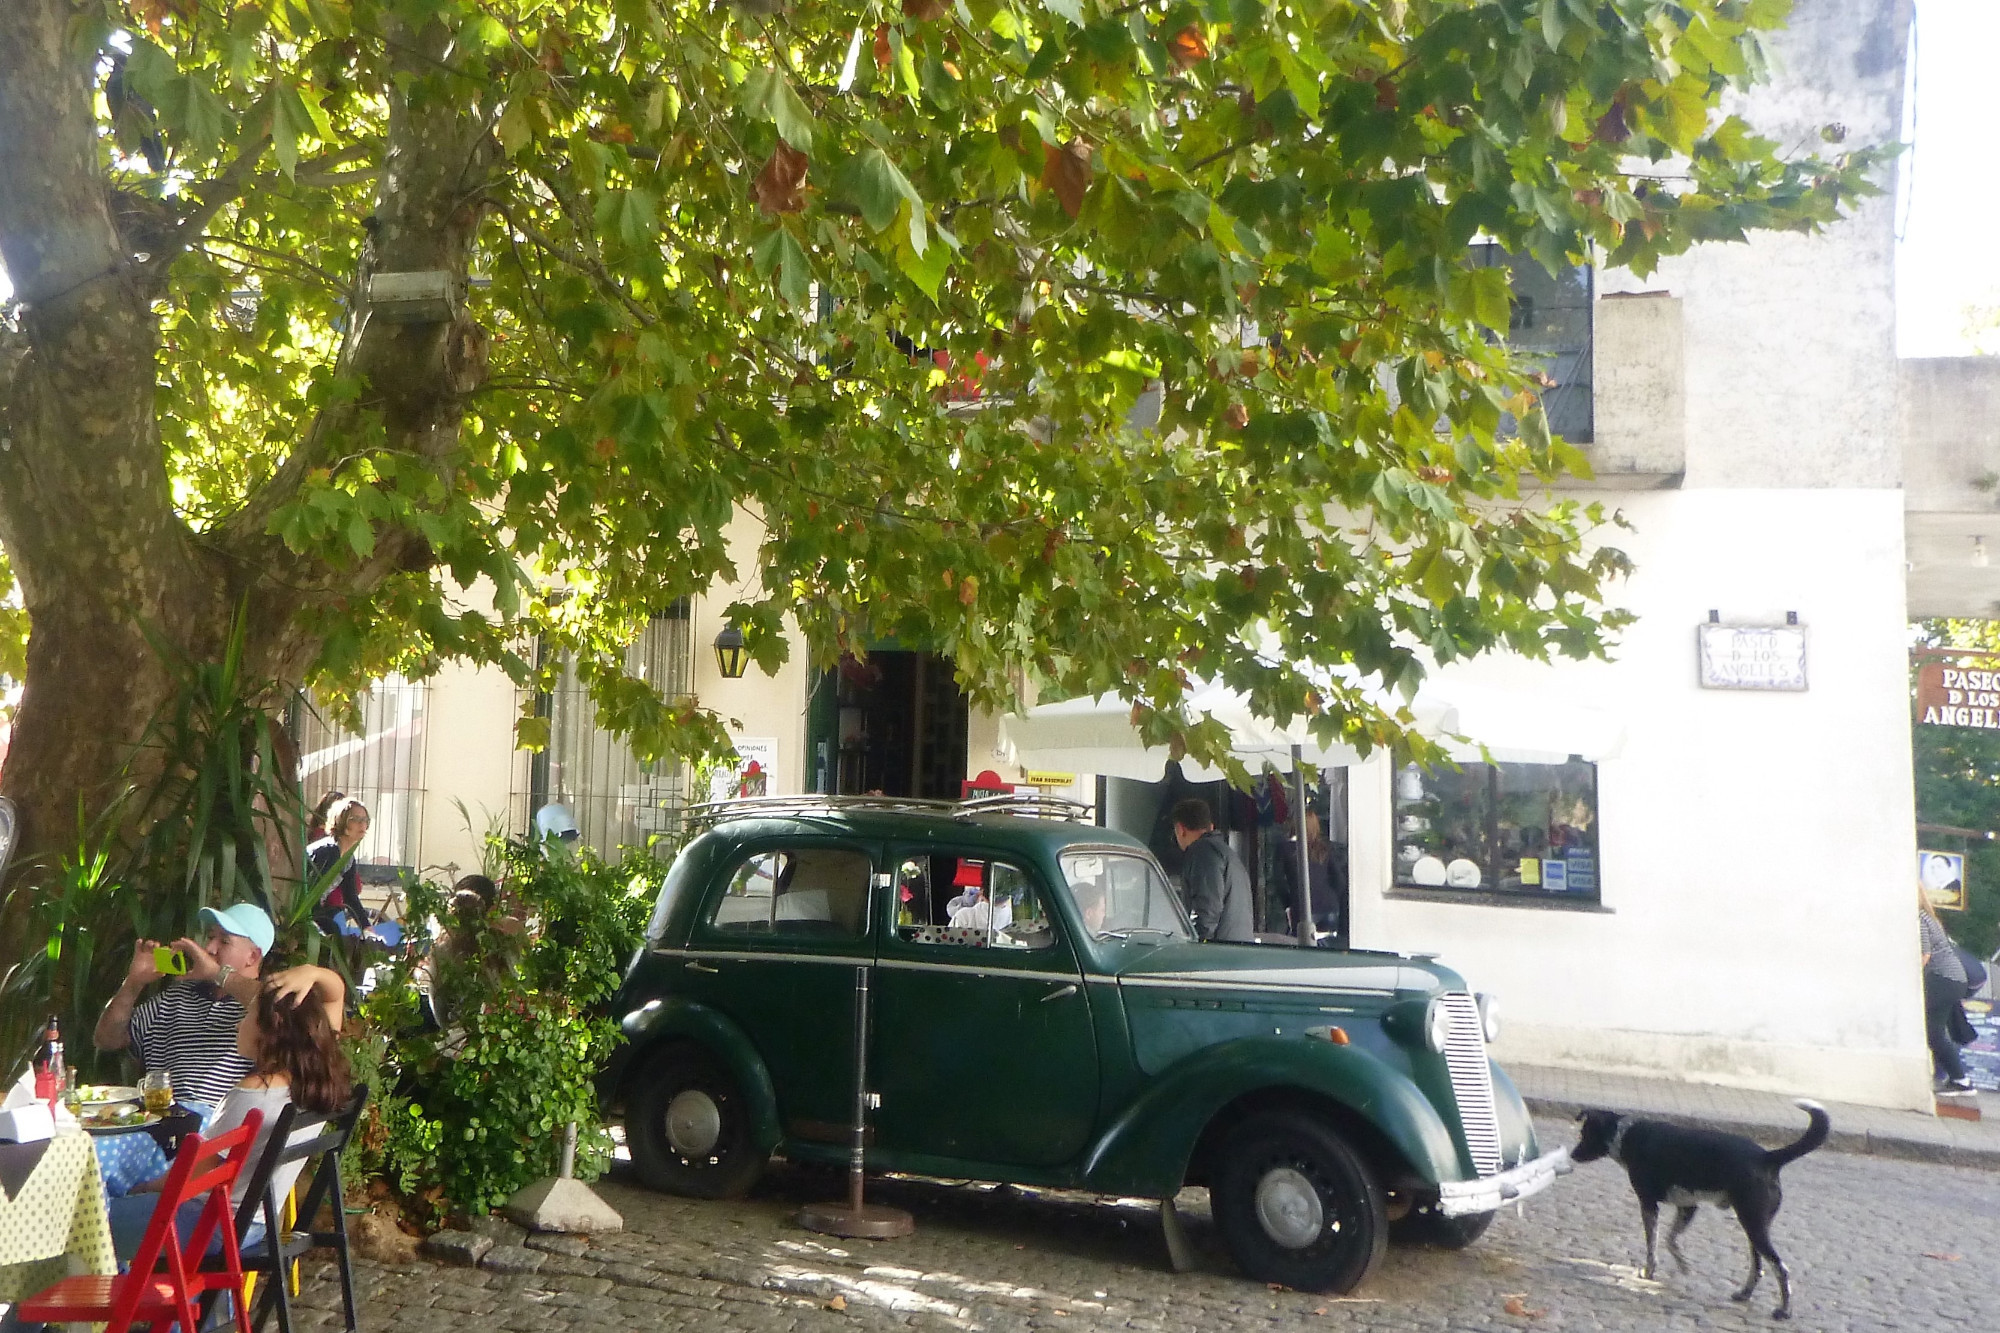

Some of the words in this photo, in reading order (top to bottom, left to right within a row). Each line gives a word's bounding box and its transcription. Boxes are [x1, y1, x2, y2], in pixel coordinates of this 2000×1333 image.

[1721, 663, 1788, 677] ANGELES
[1968, 691, 2000, 707] LOS
[1923, 706, 2000, 728] ANGEL
